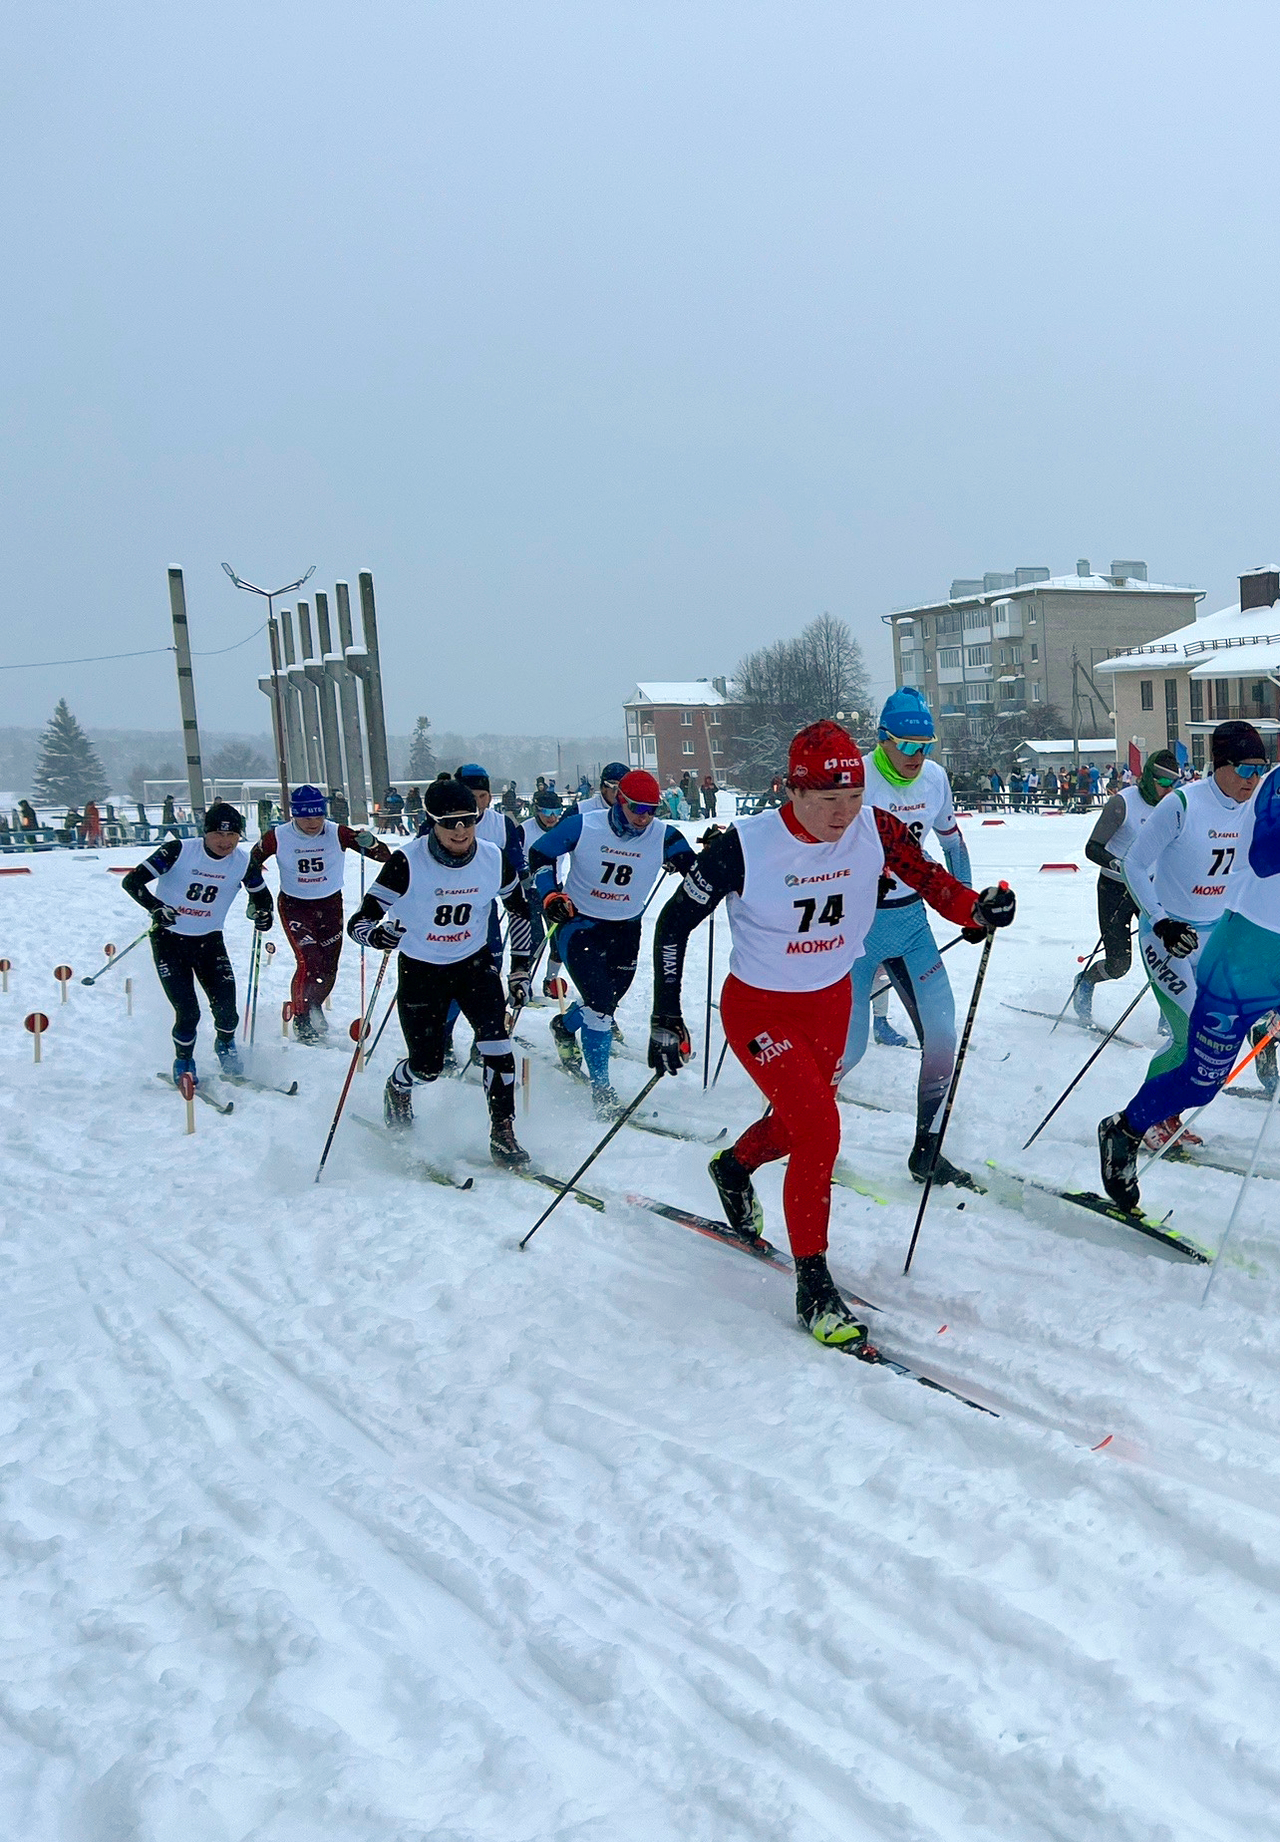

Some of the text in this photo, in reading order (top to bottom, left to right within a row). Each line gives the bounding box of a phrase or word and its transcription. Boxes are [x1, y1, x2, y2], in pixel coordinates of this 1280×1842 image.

[840, 758, 860, 768] ПСБ
[897, 802, 926, 812] FANLIFE
[608, 847, 642, 859] FANLIFE
[1207, 847, 1235, 876] 77
[297, 857, 324, 874] 85
[600, 861, 633, 886] 78
[801, 868, 851, 884] FANLIFE
[444, 887, 480, 896] FANLIFE
[694, 870, 713, 892] ПСБ
[186, 882, 219, 904] 88
[590, 888, 632, 902] МОЖГА
[433, 903, 473, 927] 80
[793, 894, 846, 934] 74
[426, 930, 472, 943] МОЖГА
[786, 933, 846, 954] МОЖГА
[662, 943, 678, 975] VMAX
[755, 1039, 794, 1066] УДМ
